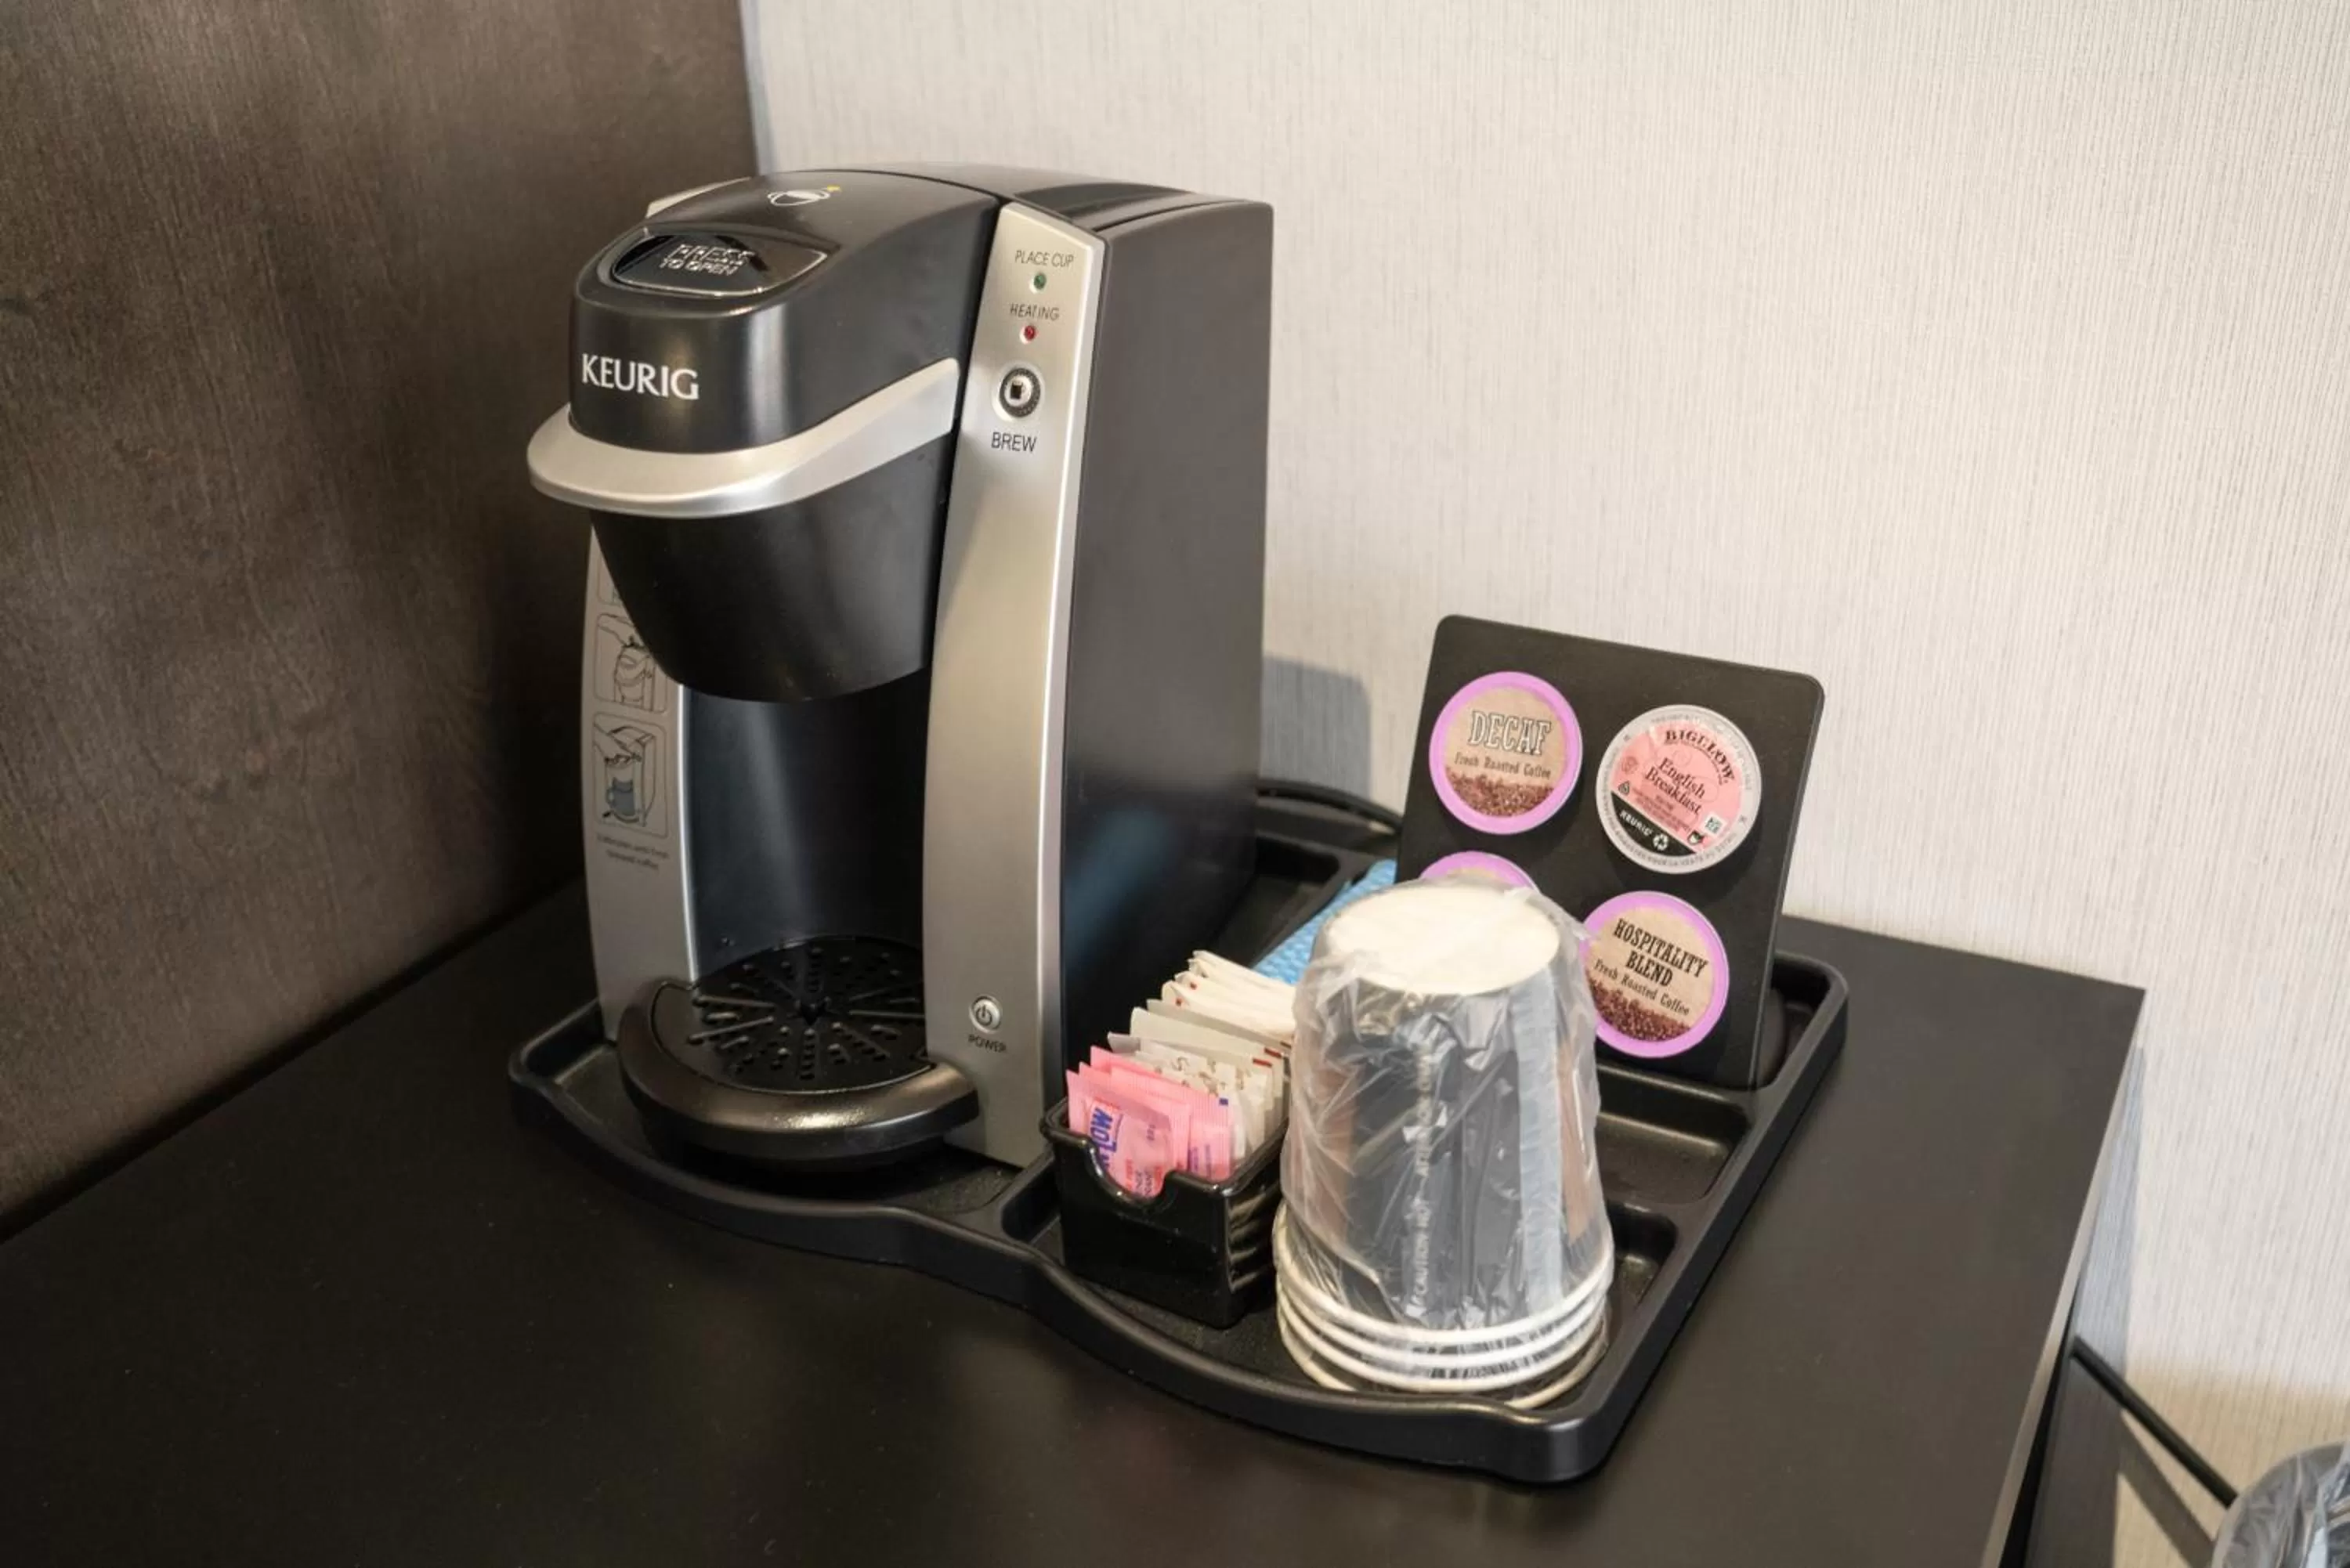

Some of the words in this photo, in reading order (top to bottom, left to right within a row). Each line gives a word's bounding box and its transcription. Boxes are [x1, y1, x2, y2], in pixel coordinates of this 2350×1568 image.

[659, 258, 685, 270] TO
[684, 260, 739, 276] OPEN
[664, 244, 756, 266] PRESS
[1014, 250, 1050, 266] PLACE
[1051, 252, 1075, 268] CUP
[1010, 302, 1061, 321] HEATING
[582, 352, 700, 400] KEURIG
[991, 432, 1038, 453] BREW
[1468, 710, 1553, 757] DECAF
[1454, 751, 1479, 767] Fresh
[1484, 757, 1520, 775] Roasted
[1524, 763, 1552, 781] Coffee
[1664, 728, 1735, 783] BIGELOW
[1645, 766, 1702, 815] Breakfast
[1657, 757, 1706, 800] English
[1613, 917, 1709, 978] HOSPITALITY
[1625, 949, 1674, 988] BLEND
[1594, 958, 1618, 981] Fresh
[1621, 973, 1658, 1002] Roasted
[1660, 992, 1690, 1017] Coffee
[1089, 1107, 1119, 1153] LOW
